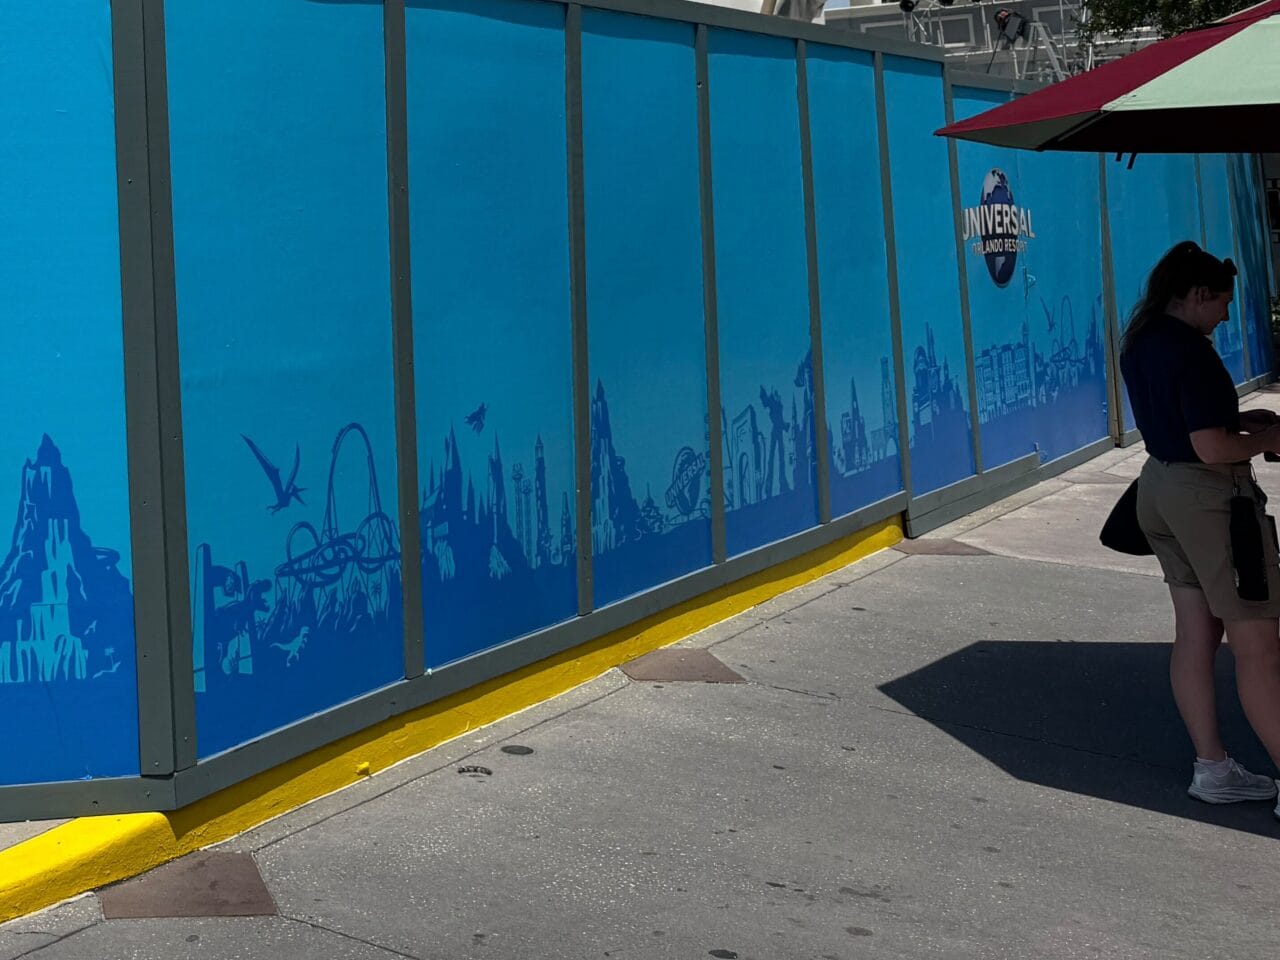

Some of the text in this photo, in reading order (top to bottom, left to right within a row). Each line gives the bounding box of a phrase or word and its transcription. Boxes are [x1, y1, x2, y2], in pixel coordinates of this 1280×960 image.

[961, 204, 1036, 240] UNIVERSAL
[972, 238, 1028, 256] ORLANDO RESORT
